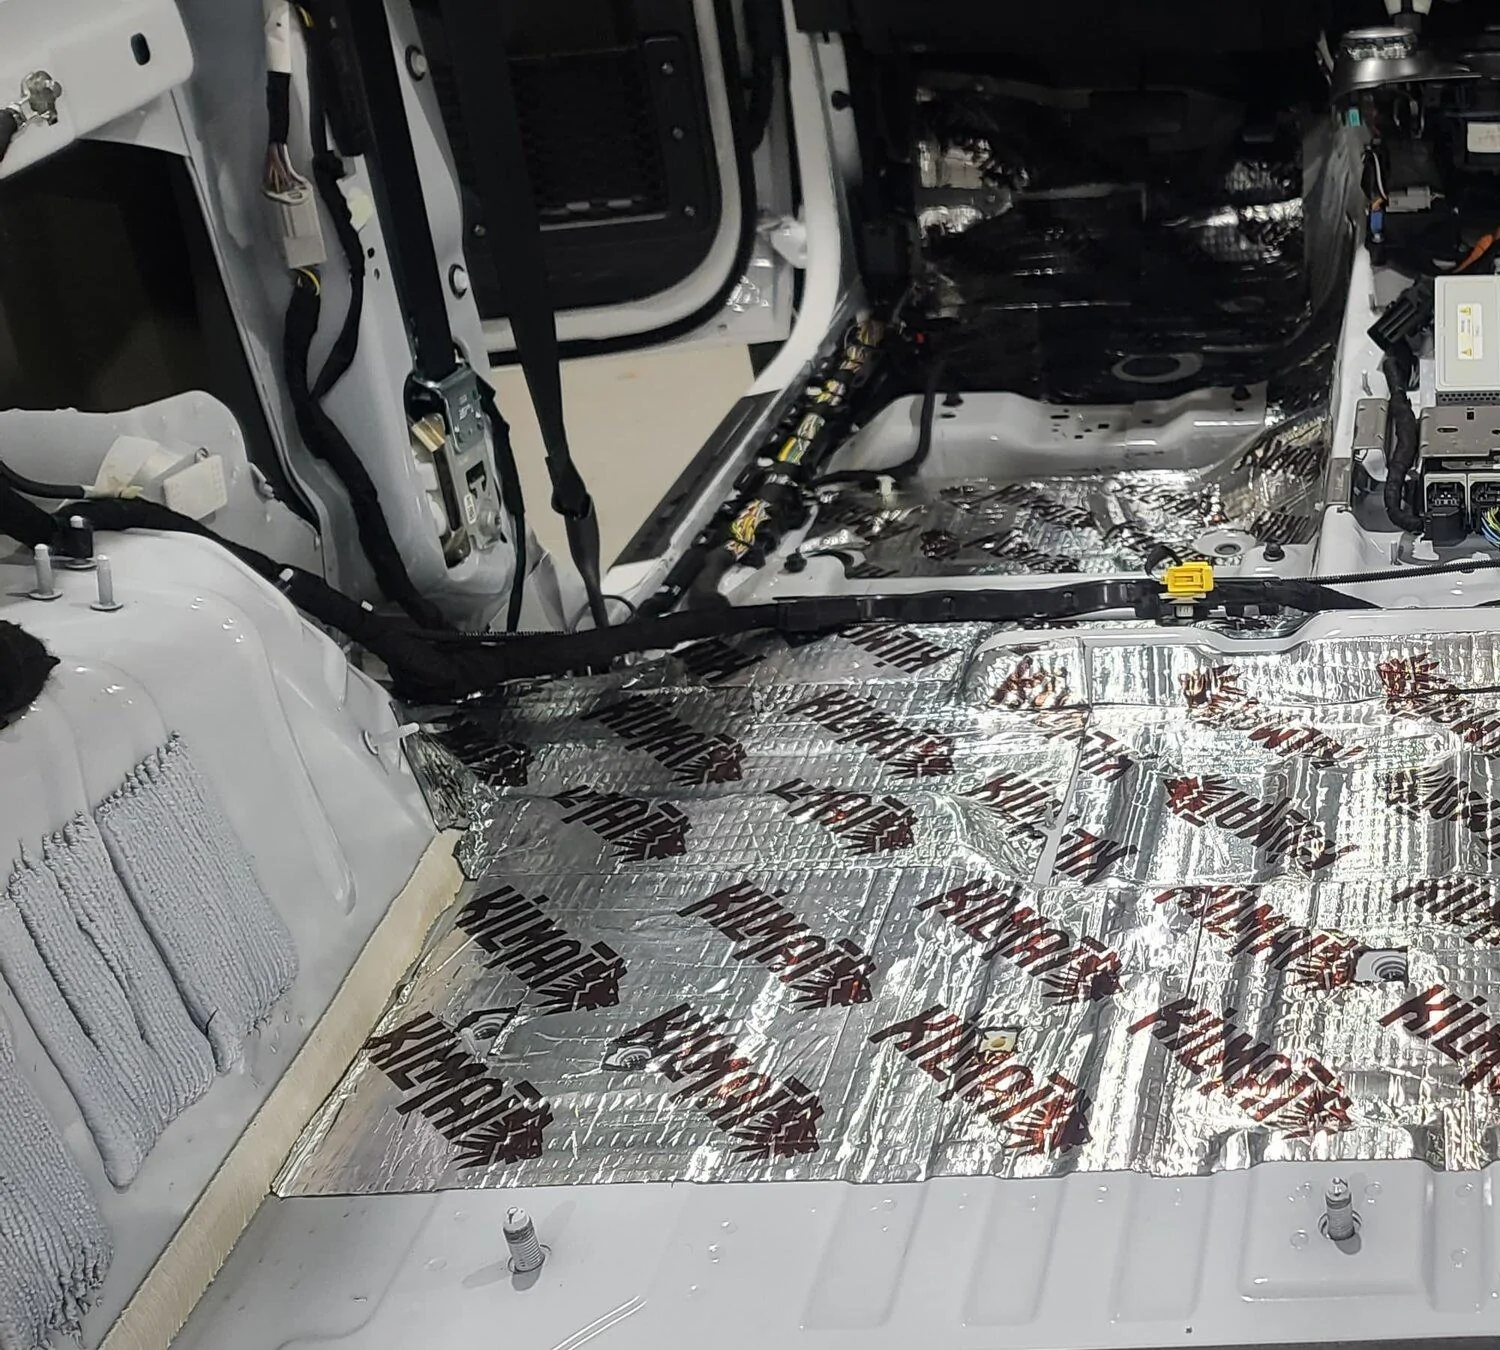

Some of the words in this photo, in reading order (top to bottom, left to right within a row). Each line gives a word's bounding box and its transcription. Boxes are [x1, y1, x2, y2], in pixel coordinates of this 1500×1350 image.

[580, 693, 736, 768] KILMAT
[784, 689, 941, 762] KILMAT
[455, 885, 619, 989] KILMAT
[676, 879, 865, 983] KILMAT
[914, 877, 1108, 977] KILMAT
[1153, 885, 1350, 971] KILMAT
[360, 1010, 545, 1142] KILMAT
[608, 1002, 813, 1132] KILMAT
[868, 1003, 1081, 1126] KILMAT
[1125, 996, 1337, 1122] KILMAT
